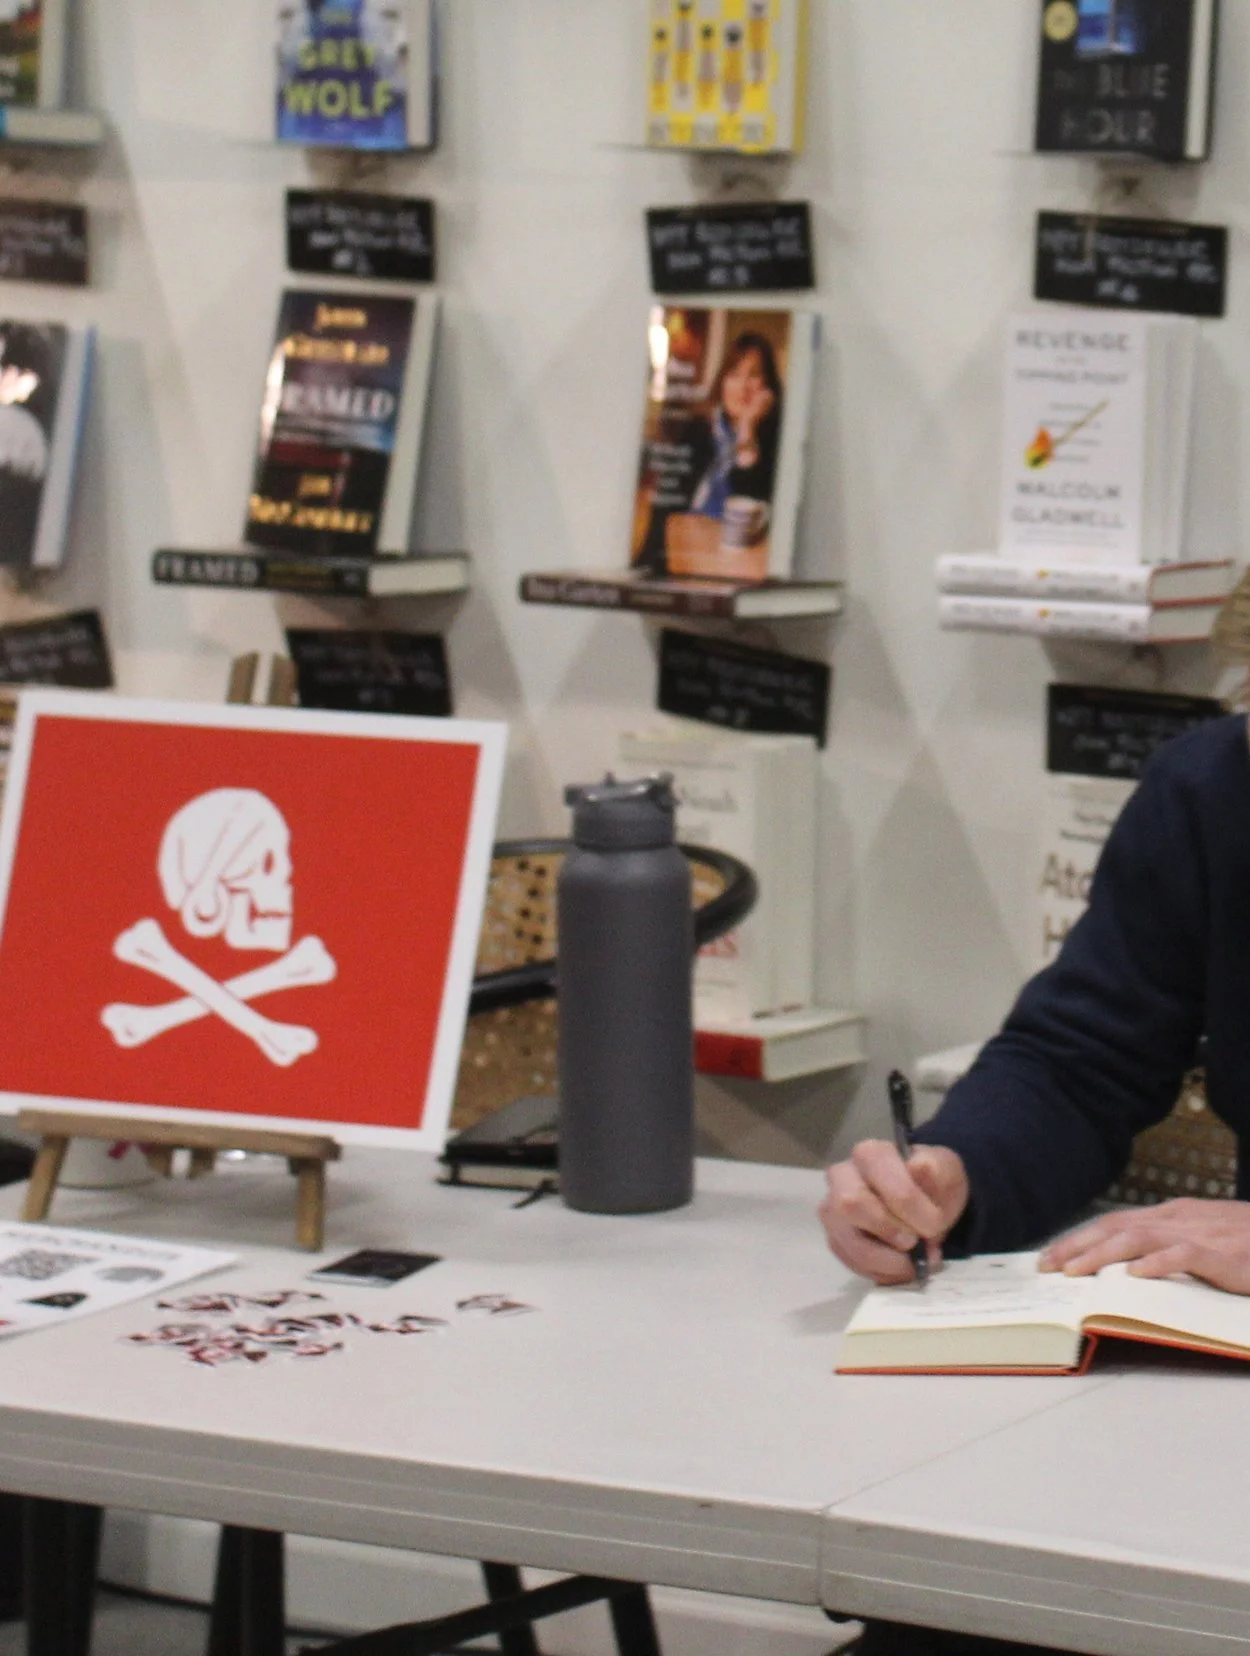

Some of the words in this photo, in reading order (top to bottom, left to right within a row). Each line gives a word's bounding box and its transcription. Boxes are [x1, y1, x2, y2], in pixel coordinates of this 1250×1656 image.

[298, 38, 378, 70] GREY
[284, 80, 393, 119] WOLF
[1016, 330, 1131, 352] REVENGE
[1015, 481, 1120, 501] MALCOLM
[1011, 505, 1124, 530] GLADWELL
[156, 556, 259, 583] FRAMED
